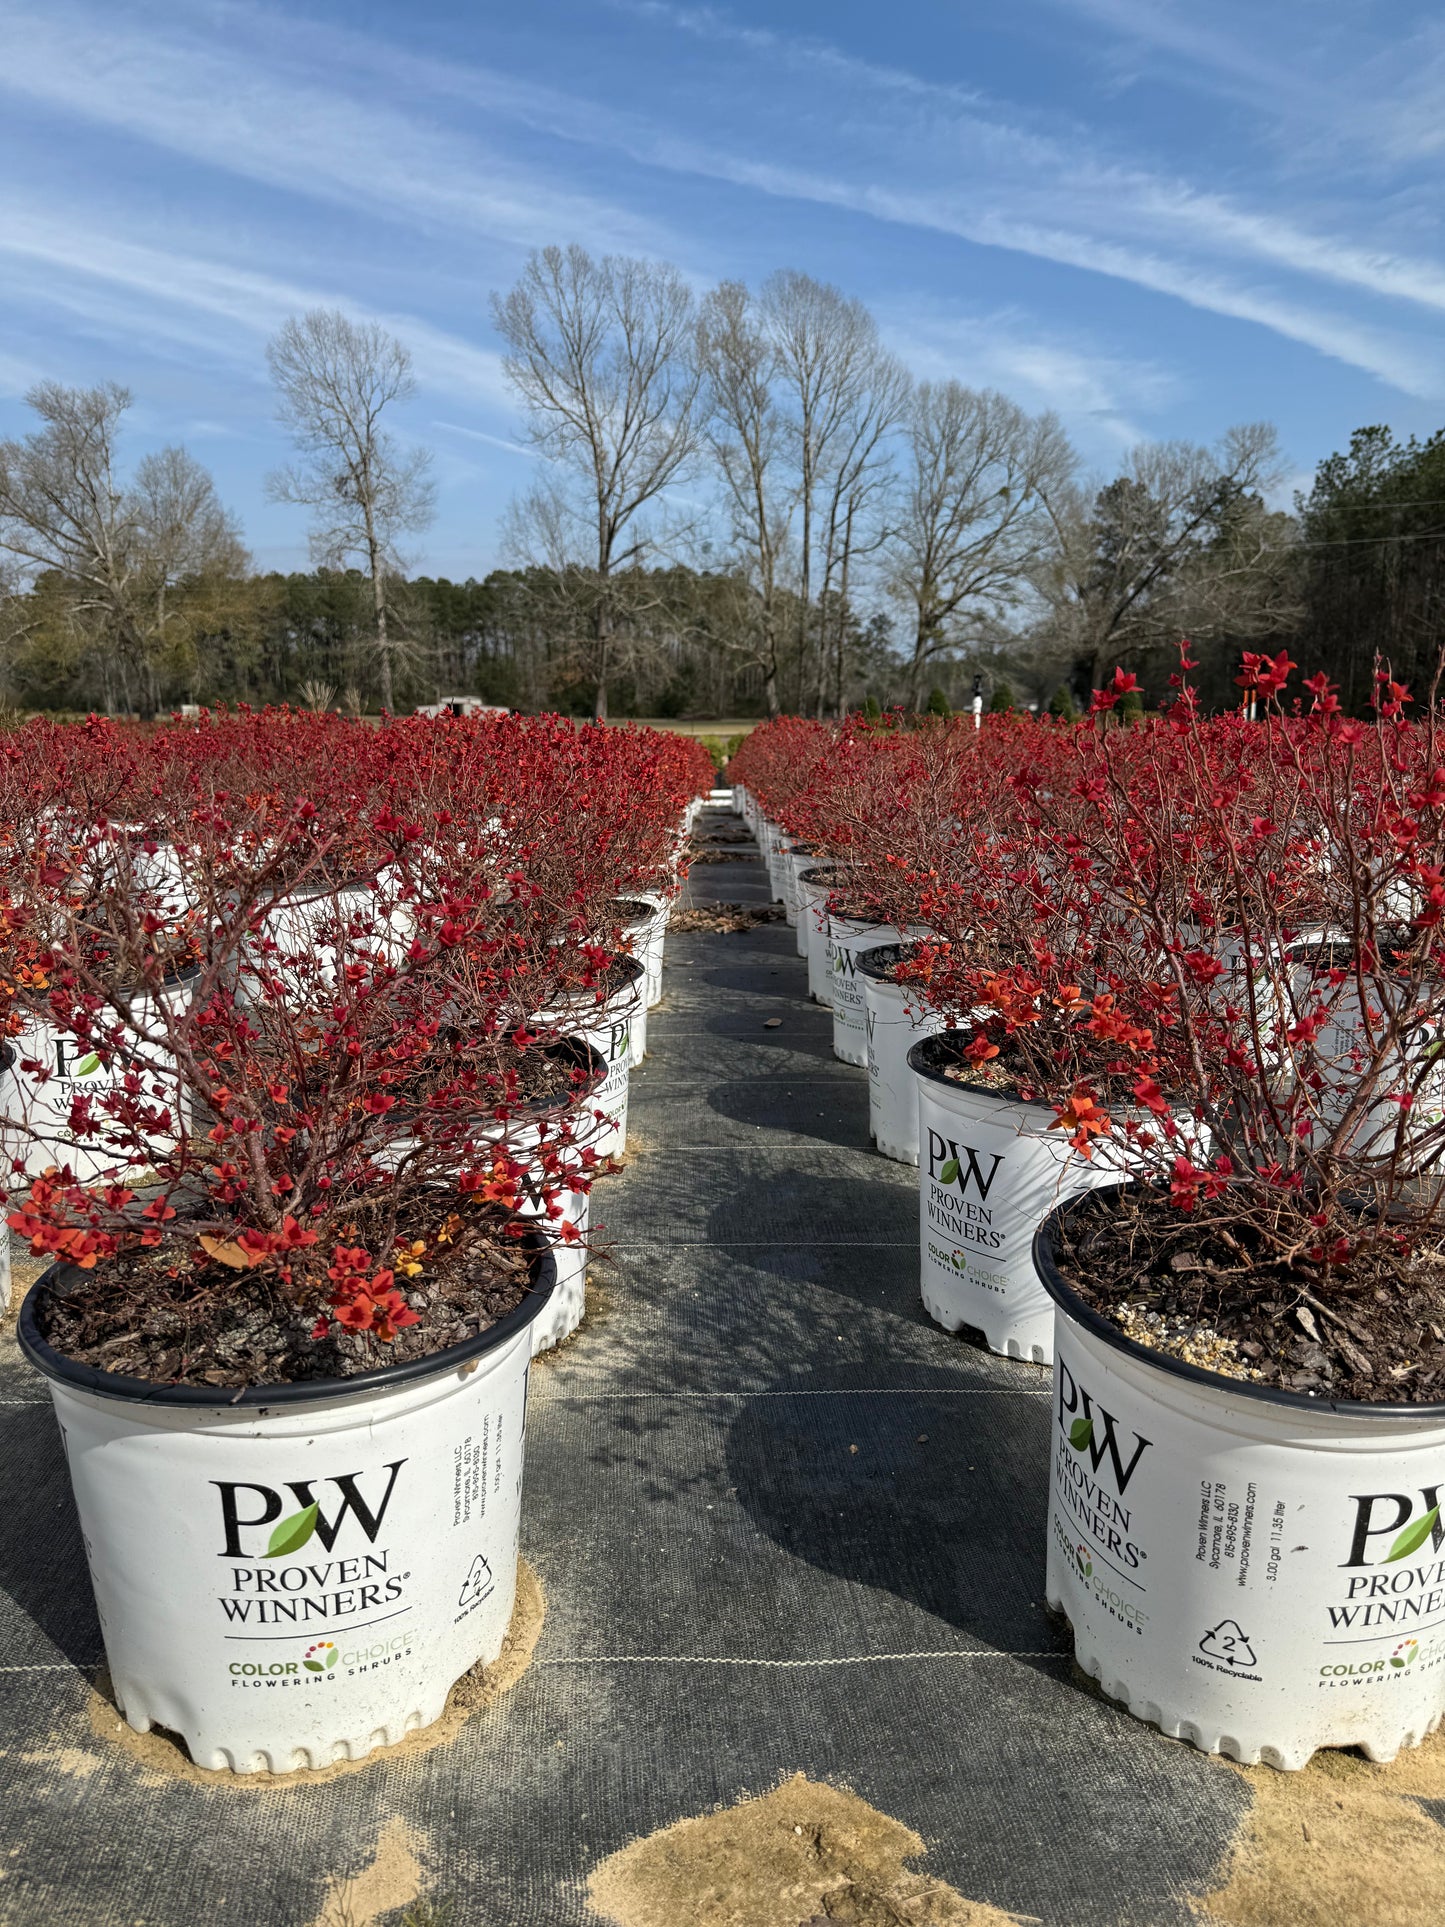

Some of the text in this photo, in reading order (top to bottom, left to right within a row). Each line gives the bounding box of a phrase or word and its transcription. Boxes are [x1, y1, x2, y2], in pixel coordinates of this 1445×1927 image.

[927, 1126, 1005, 1201] PW
[930, 1183, 993, 1225] PROVEN
[928, 1242, 950, 1264] COLOR
[928, 1253, 1005, 1294] FLOWERING SHRUBS
[1058, 1351, 1153, 1496] PW
[453, 1445, 462, 1527] Proven Winners LLC
[463, 1436, 472, 1523] Sycamore, IL 60178
[1059, 1435, 1132, 1533] PROVEN
[1214, 1483, 1226, 1512] 60178
[208, 1457, 409, 1559] PW
[1196, 1480, 1212, 1561] Proven Winners LLC
[1054, 1513, 1075, 1558] COLOR
[1209, 1524, 1223, 1569] Sycamore,
[1224, 1503, 1239, 1558] 815-895-8130
[1238, 1482, 1257, 1587] www.provenwinners.com
[1266, 1501, 1286, 1581] 3.00 gal 11.35 liter
[230, 1549, 390, 1592] PROVEN
[1345, 1560, 1445, 1600] PROVE
[1095, 1593, 1142, 1635] SHRUBS
[1326, 1587, 1445, 1629] WINNE
[1222, 1636, 1236, 1652] 2
[229, 1662, 299, 1677] COLOR
[231, 1647, 412, 1688] FLOWERING SHRUBS
[1191, 1655, 1263, 1682] 100% Recyclable
[1319, 1669, 1411, 1688] FLOWERING
[1320, 1660, 1386, 1677] COLOR
